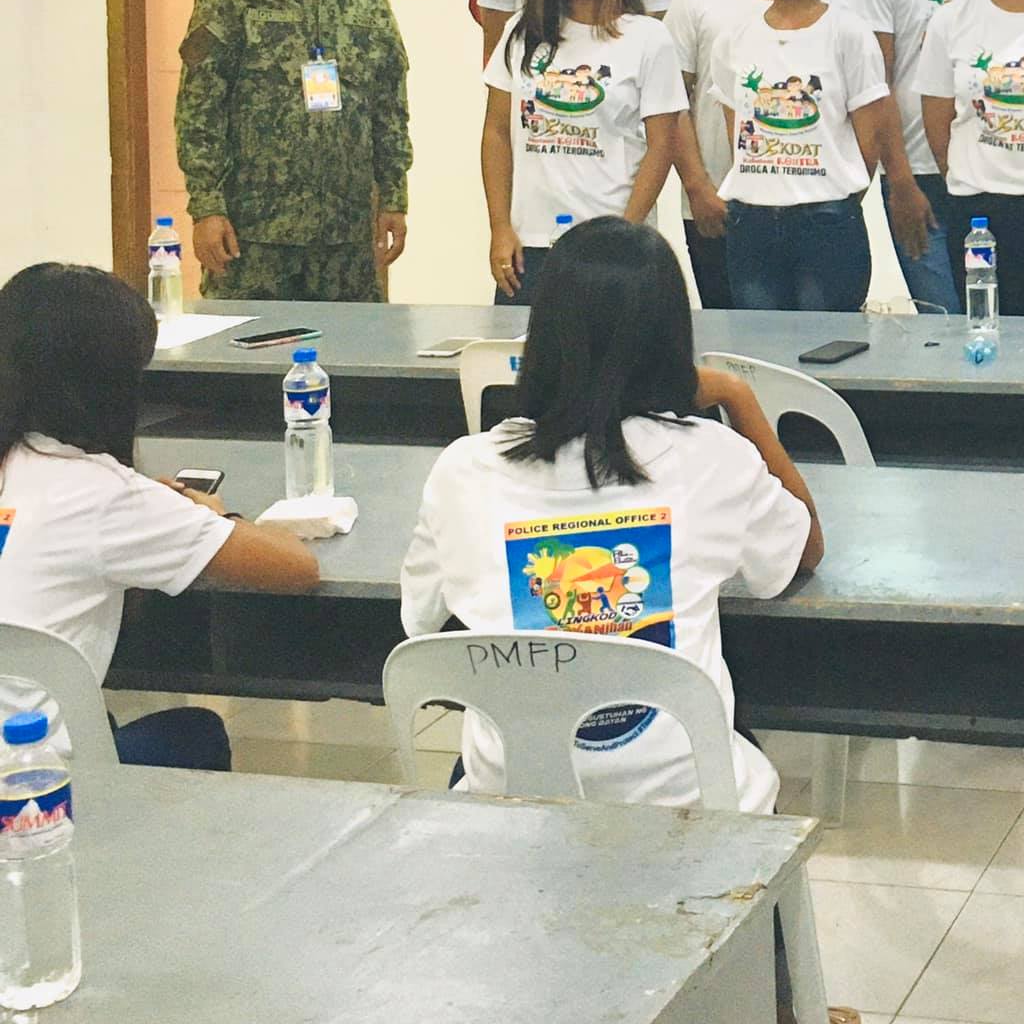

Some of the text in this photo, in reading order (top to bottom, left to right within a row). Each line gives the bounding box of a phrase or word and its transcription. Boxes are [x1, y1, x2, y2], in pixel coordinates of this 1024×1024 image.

[508, 525, 549, 535] POLICE
[552, 519, 611, 530] REGIONAL
[616, 514, 656, 524] OFFICE
[557, 611, 617, 626] LINGKOD
[467, 641, 577, 674] PMFP
